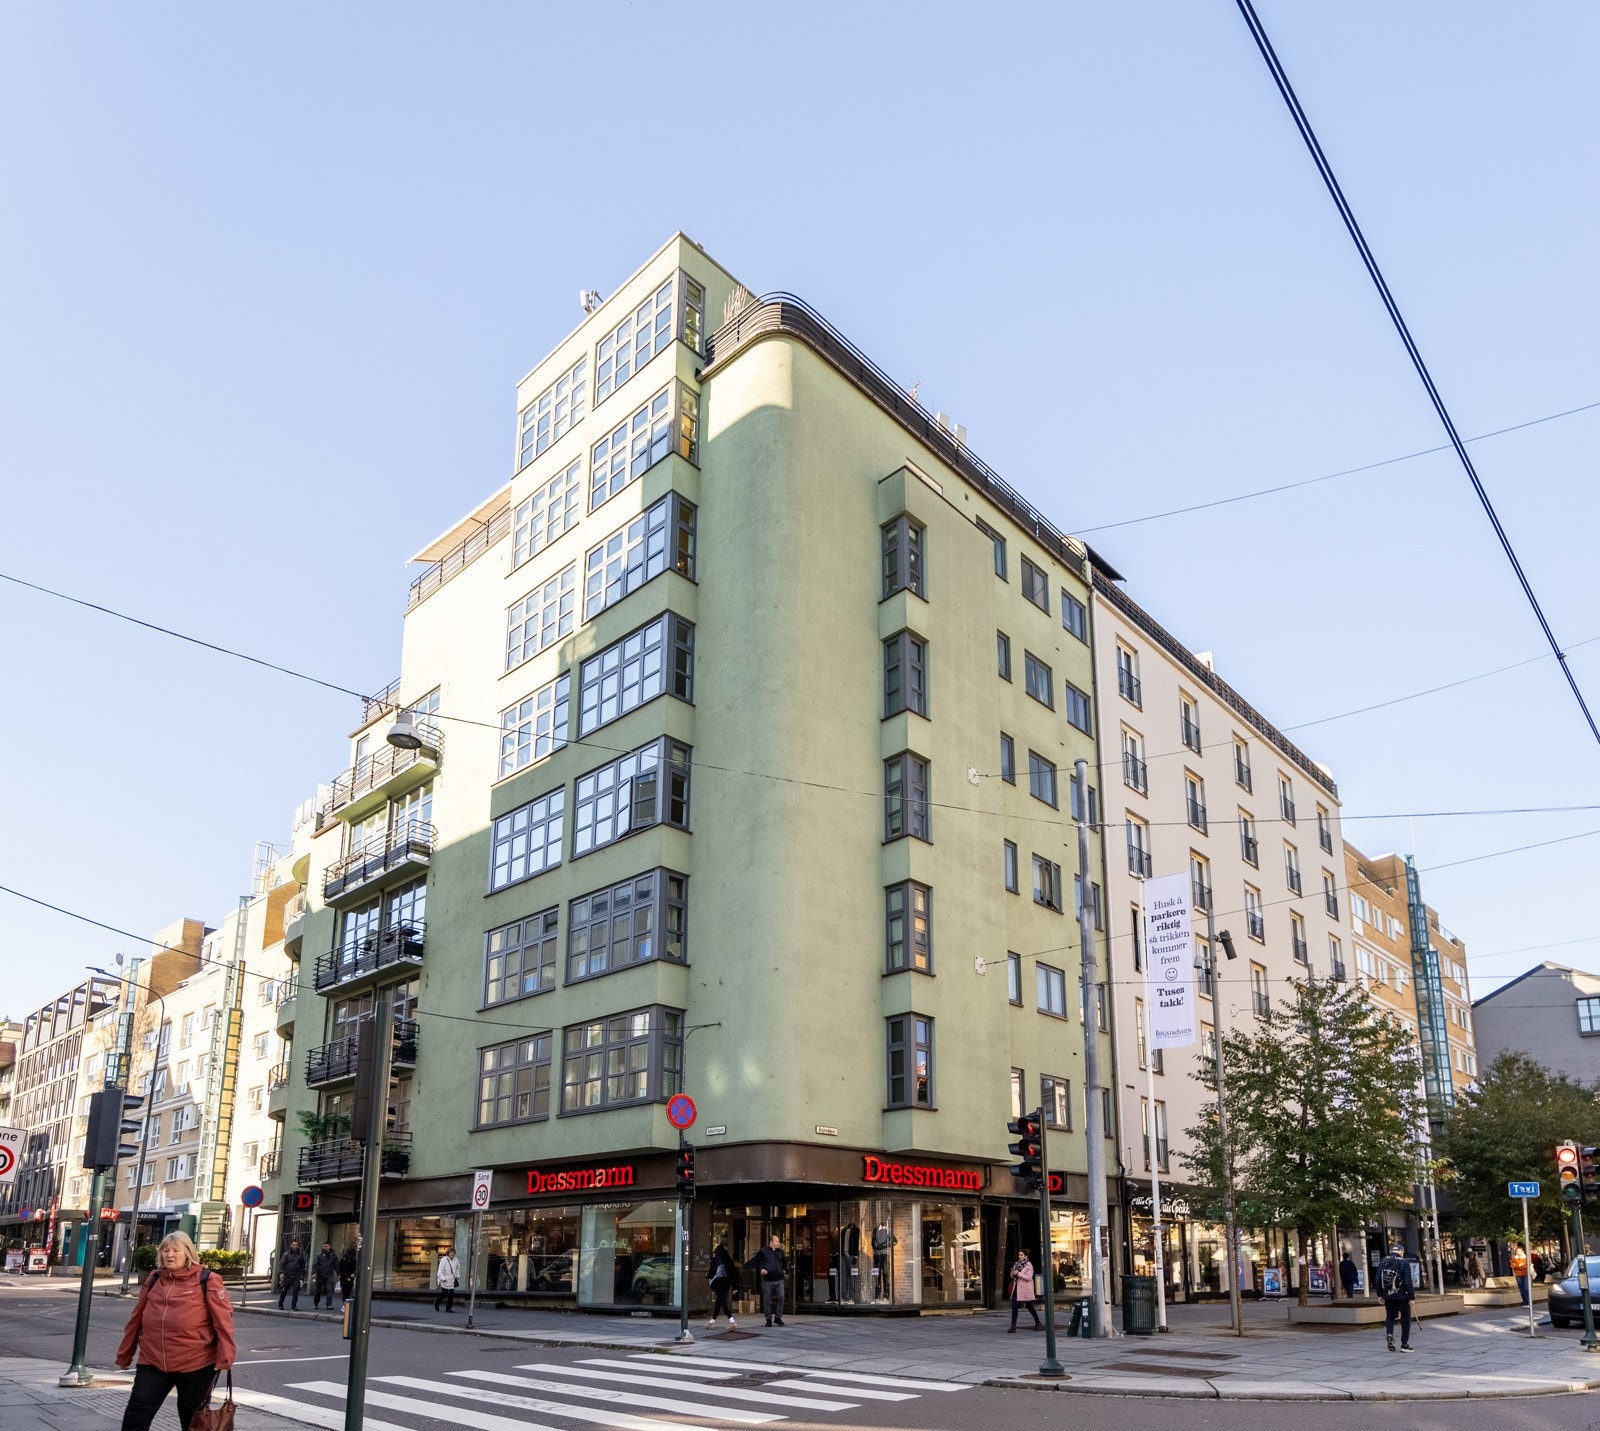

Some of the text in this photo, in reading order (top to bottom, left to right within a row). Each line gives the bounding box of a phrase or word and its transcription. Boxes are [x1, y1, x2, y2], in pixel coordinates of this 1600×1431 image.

[1154, 896, 1182, 910] Husk å
[1151, 909, 1186, 923] parkere
[1156, 919, 1181, 931] riktig
[1149, 930, 1190, 943] så trikken
[1152, 943, 1187, 954] kommer
[1161, 956, 1180, 964] frem
[1157, 987, 1185, 997] Tusen
[1160, 996, 1184, 1008] takk!
[0, 1132, 18, 1141] ne
[864, 1156, 980, 1189] Dressmann
[527, 1165, 633, 1193] Dressmann
[1048, 1175, 1062, 1190] D
[1513, 1184, 1535, 1193] Taxi
[297, 1195, 311, 1208] D
[478, 1190, 486, 1201] 30
